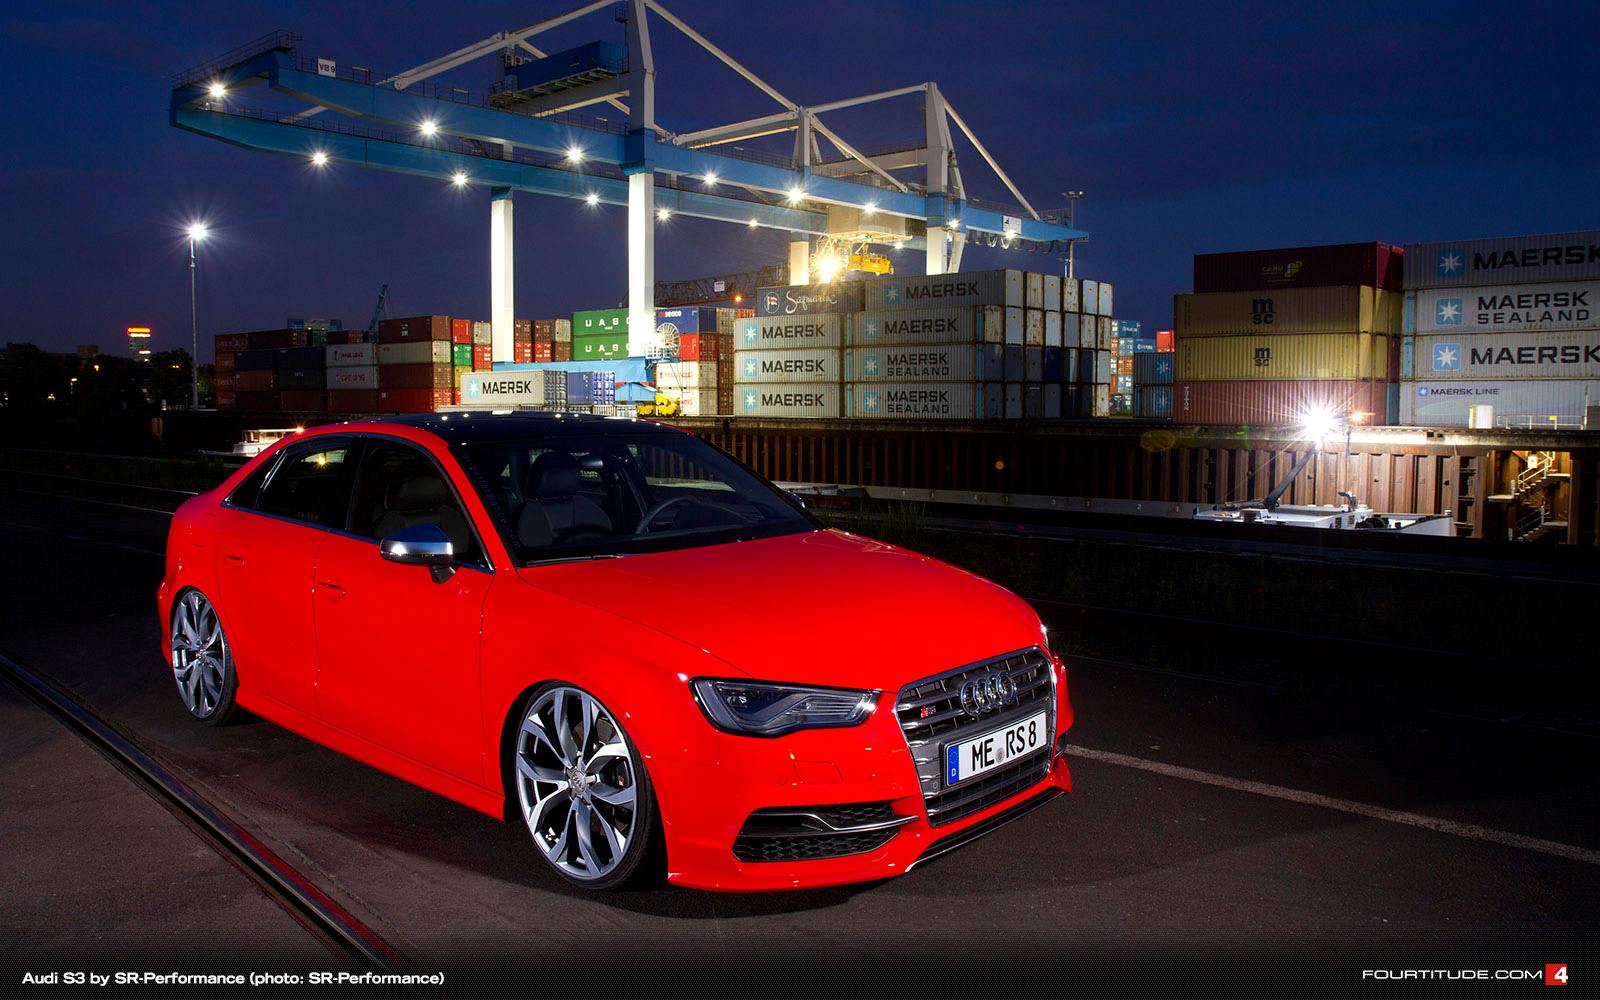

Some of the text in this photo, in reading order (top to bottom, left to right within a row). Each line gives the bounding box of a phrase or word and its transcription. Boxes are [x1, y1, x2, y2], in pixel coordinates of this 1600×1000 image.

[1474, 244, 1600, 270] MAERSK
[905, 281, 980, 300] MAERSK
[1478, 290, 1590, 311] MAERSK
[1477, 308, 1590, 325] SEALAND
[762, 323, 825, 340] MAERSK
[884, 317, 958, 334] MAERSK
[887, 353, 949, 365] MAERSK
[1470, 345, 1600, 365] MAERSK
[762, 359, 825, 373] MAERSK
[887, 366, 949, 377] SEALAND
[482, 380, 532, 394] MAERSK
[1430, 388, 1473, 396] MAERSK
[762, 393, 825, 407] MAERSK
[887, 390, 949, 402] MAERSK
[887, 404, 950, 414] SEALAND
[971, 720, 1037, 772] ME RS 8
